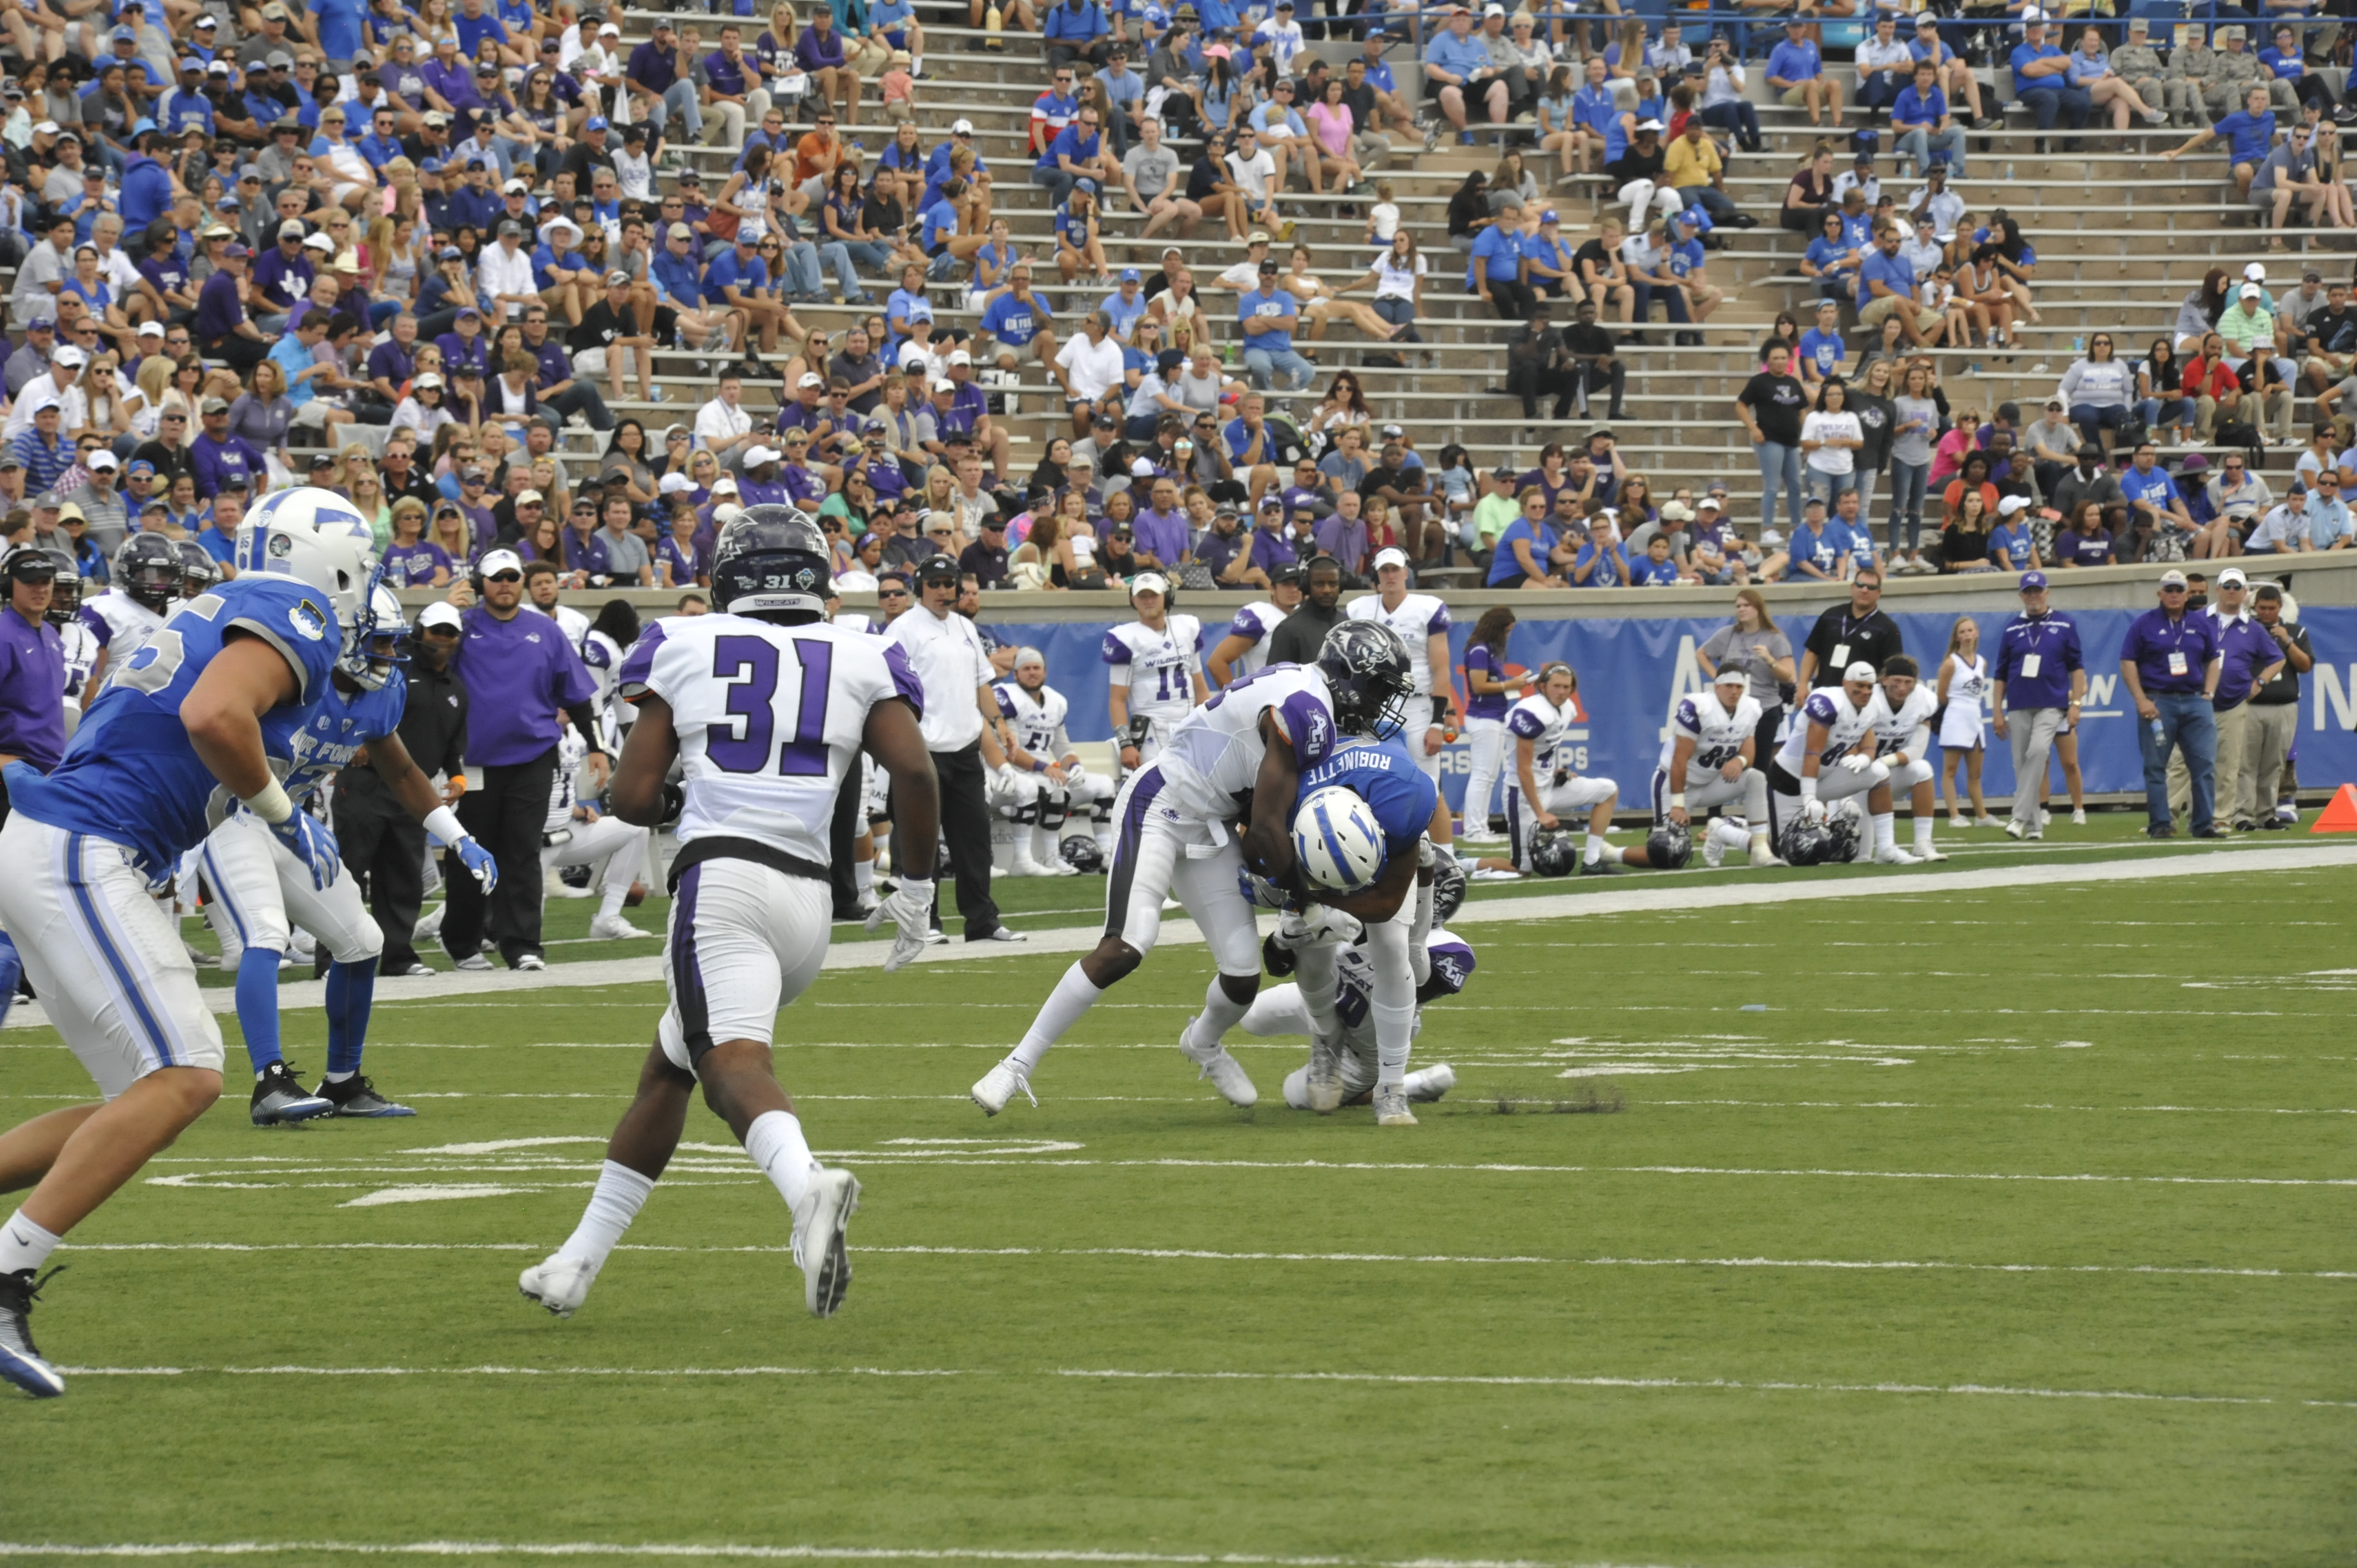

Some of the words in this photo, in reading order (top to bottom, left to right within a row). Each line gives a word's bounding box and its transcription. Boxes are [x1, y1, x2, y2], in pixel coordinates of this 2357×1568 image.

[764, 575, 791, 589] 31
[755, 599, 800, 607] WILDCATS
[1156, 663, 1189, 701] 14
[705, 635, 833, 776] 31
[1678, 704, 1694, 723] ACU
[1810, 698, 1828, 718] ACU
[1514, 714, 1534, 733] ACU
[1307, 713, 1327, 756] ACU
[316, 741, 363, 762] FORC
[1307, 750, 1392, 786] ROBINETTE
[1436, 956, 1464, 988] ACU
